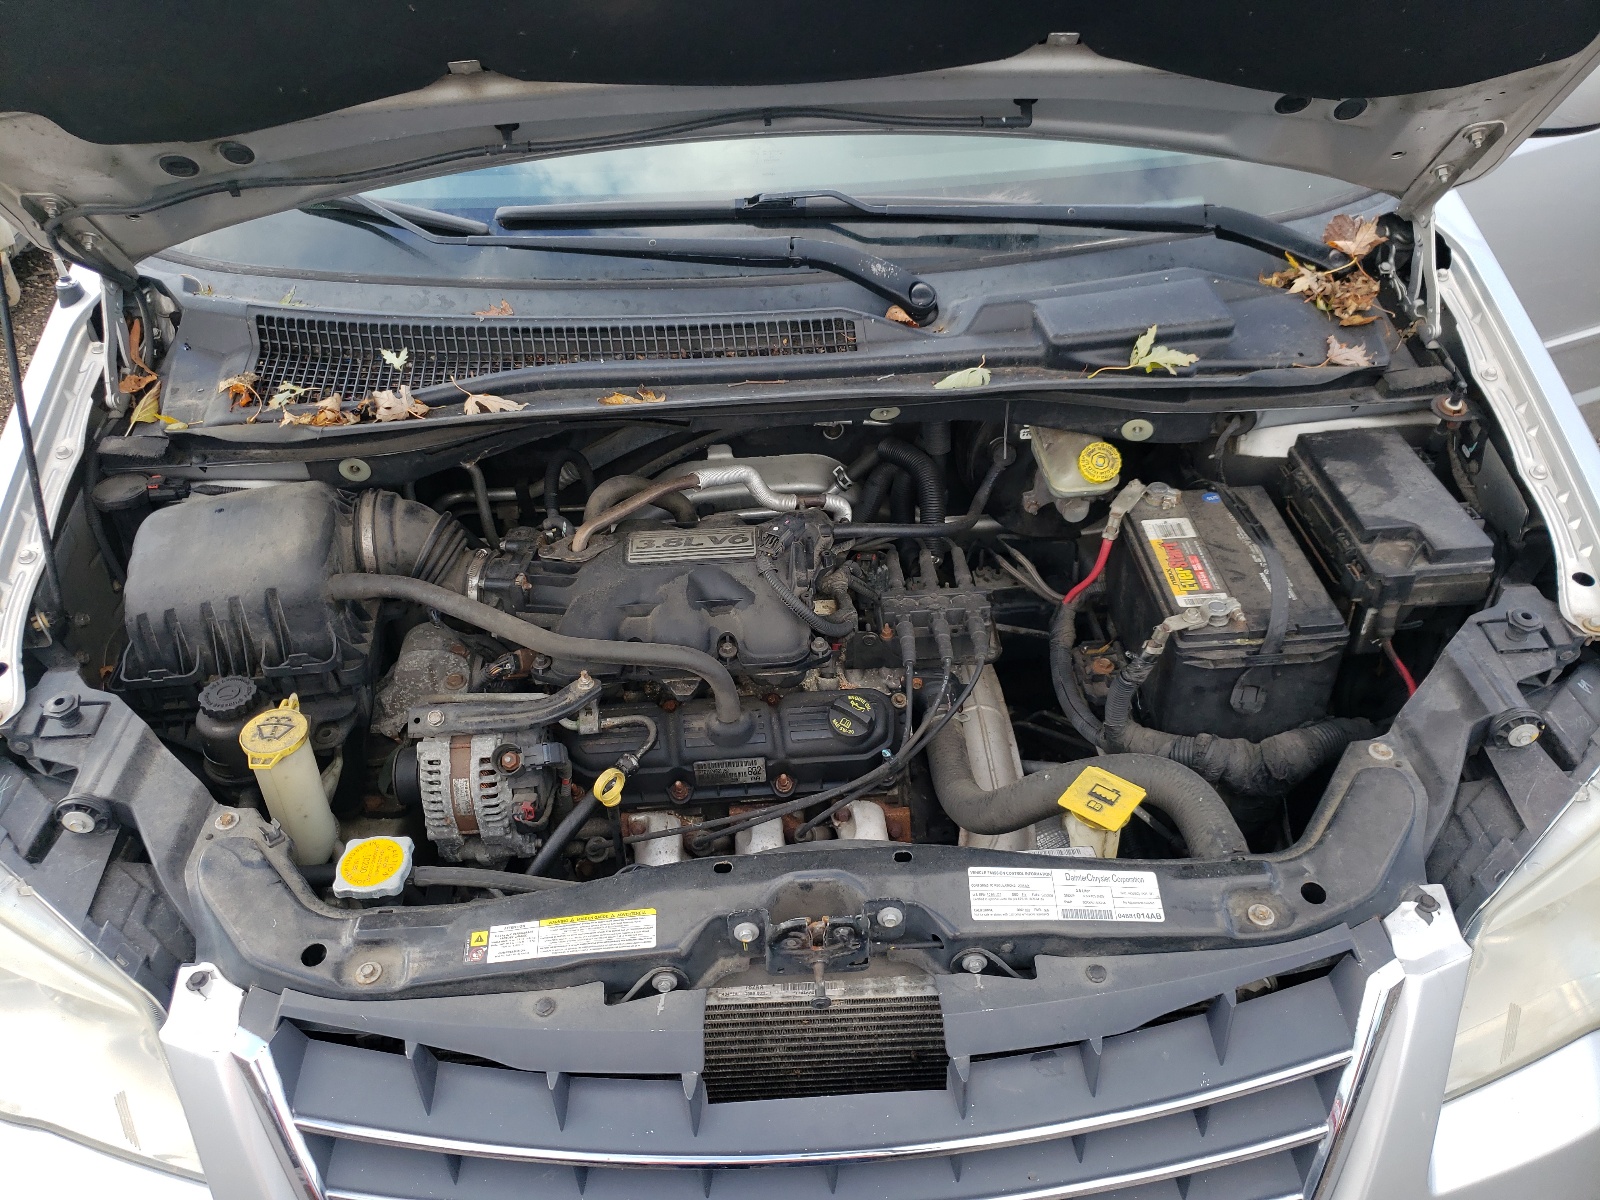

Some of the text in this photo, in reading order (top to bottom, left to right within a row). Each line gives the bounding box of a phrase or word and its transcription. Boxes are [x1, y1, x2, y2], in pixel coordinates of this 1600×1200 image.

[635, 533, 750, 550] 3.8L V6
[1111, 873, 1145, 885] Corporation
